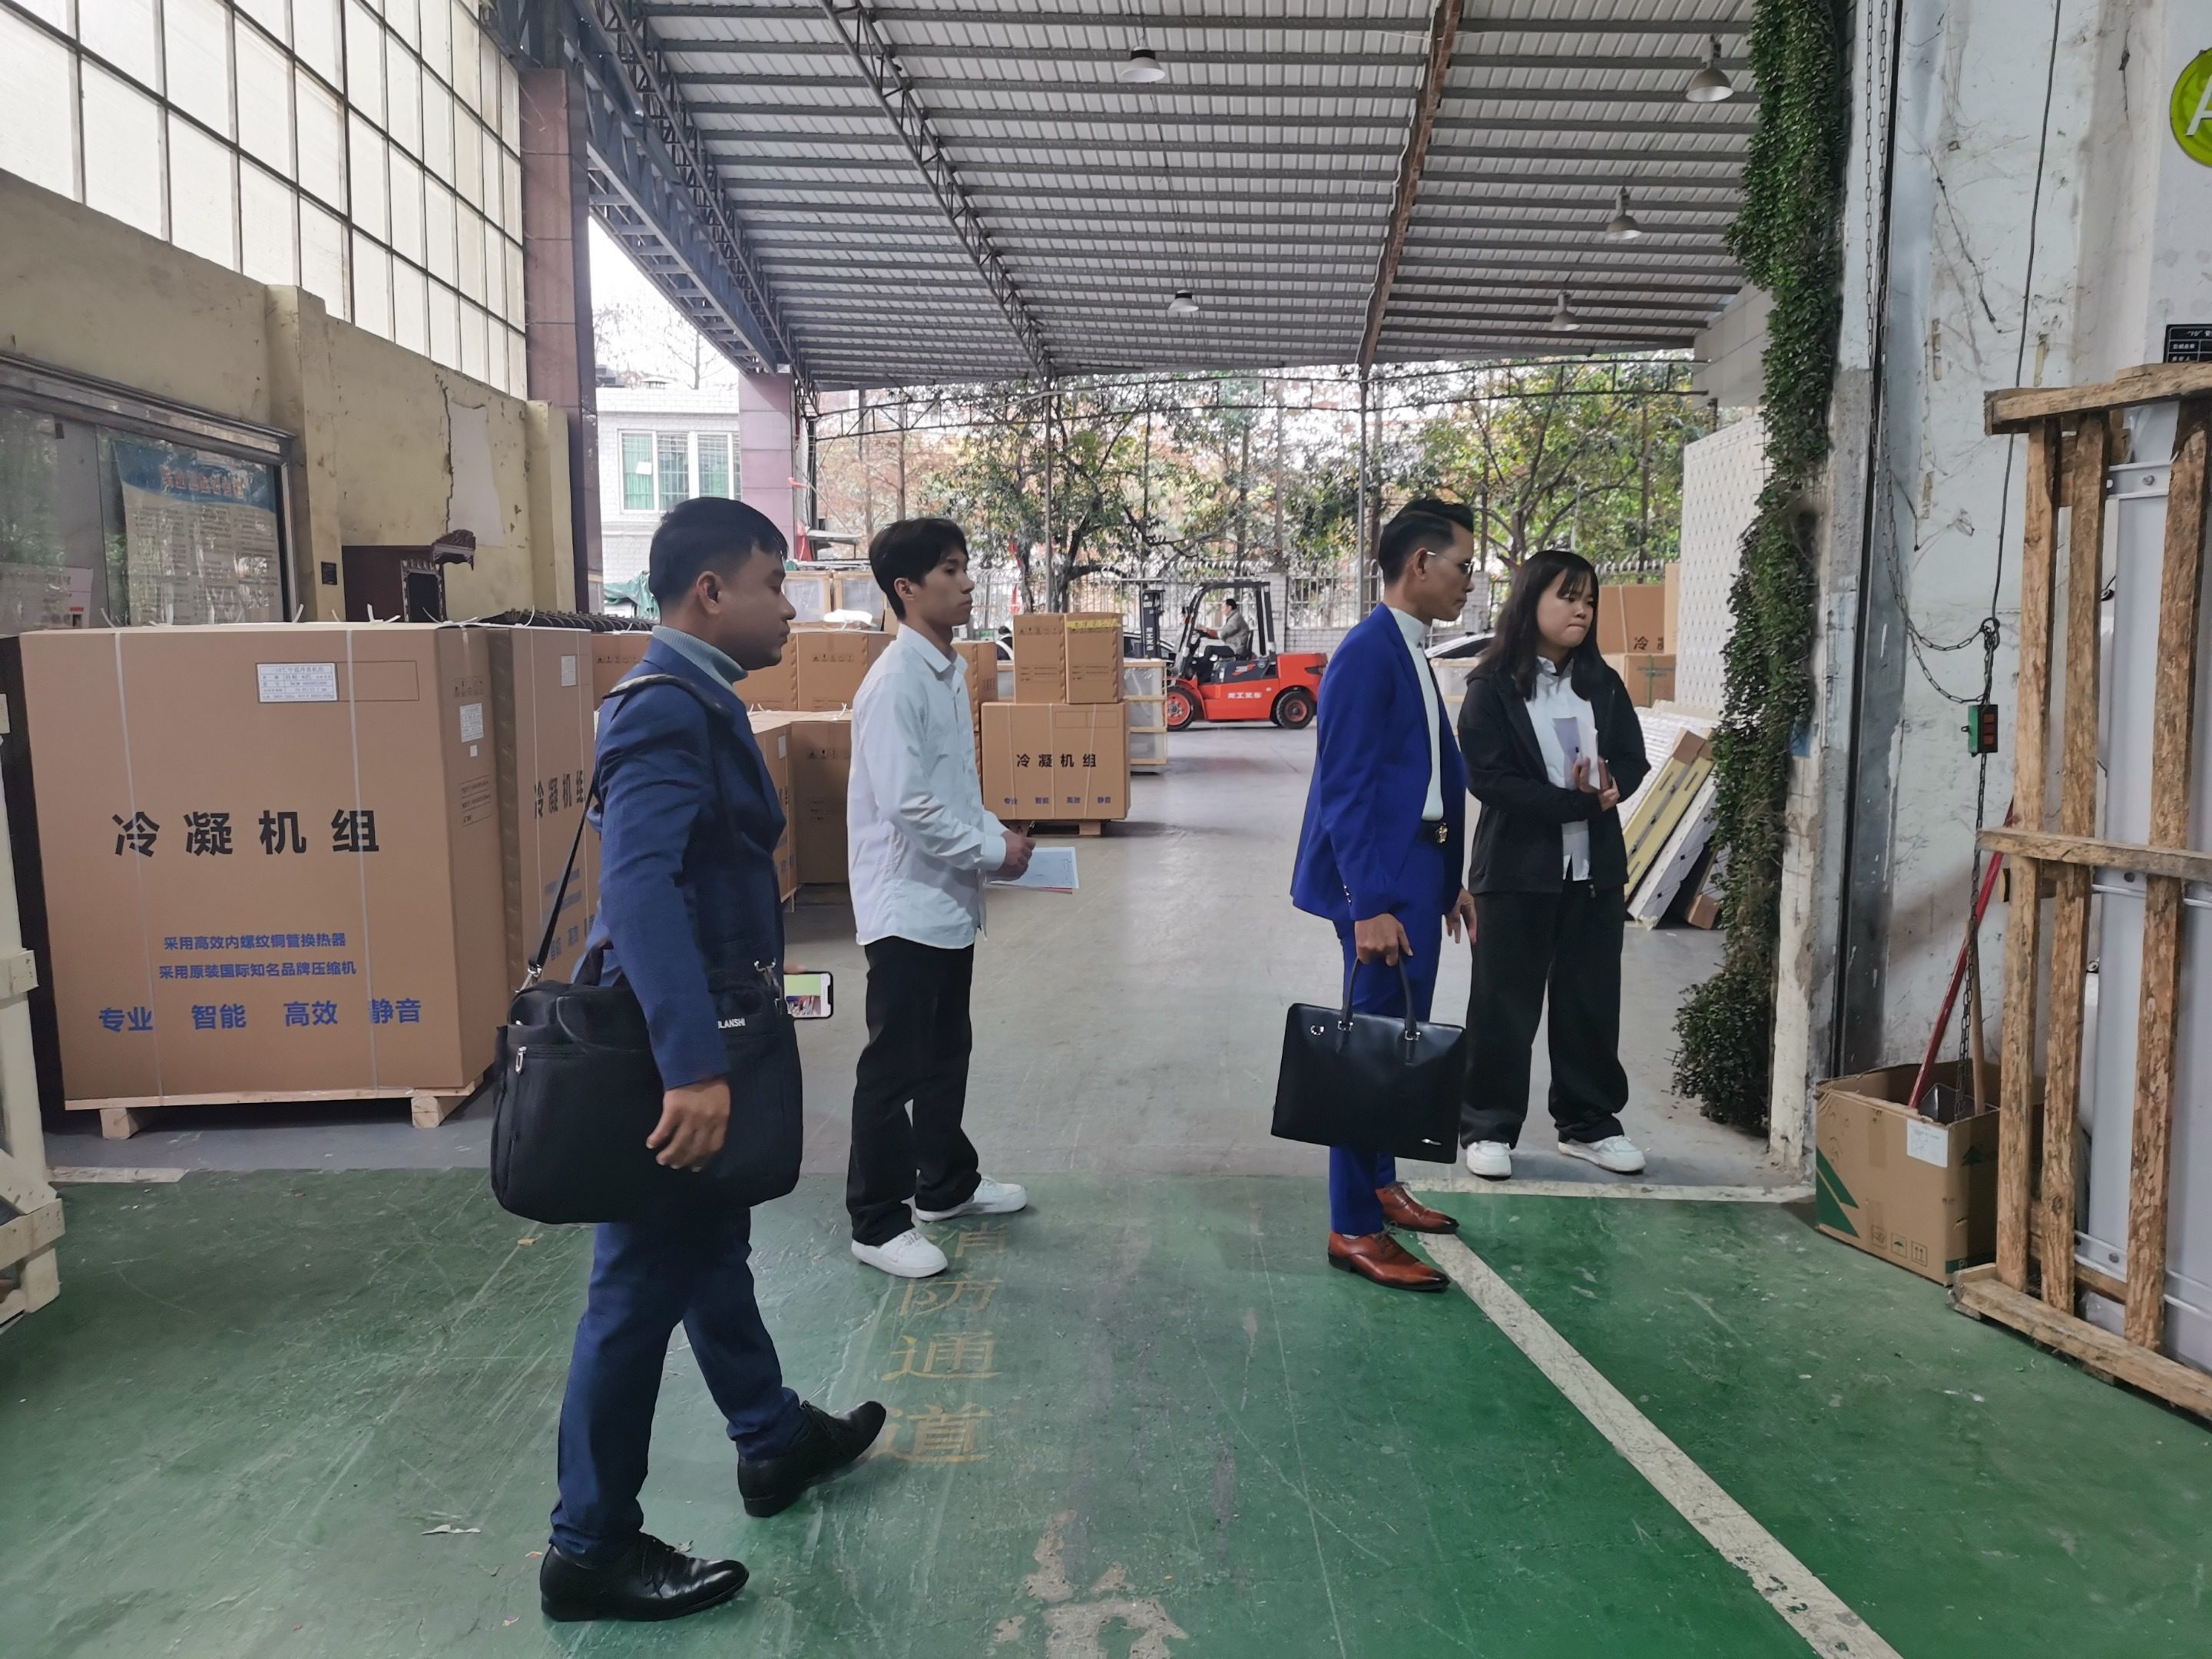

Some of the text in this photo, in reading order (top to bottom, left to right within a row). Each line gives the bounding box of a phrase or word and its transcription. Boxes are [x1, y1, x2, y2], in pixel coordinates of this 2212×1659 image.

[1016, 753, 1097, 768] 冷凝机组
[111, 809, 379, 857] 冷凝机组
[164, 932, 346, 951] 采用高效内螺纹铜管换热器
[159, 961, 356, 979] 采用原装国际知名品牌压缩机
[99, 998, 422, 1033] 专业 智能 高效 静音
